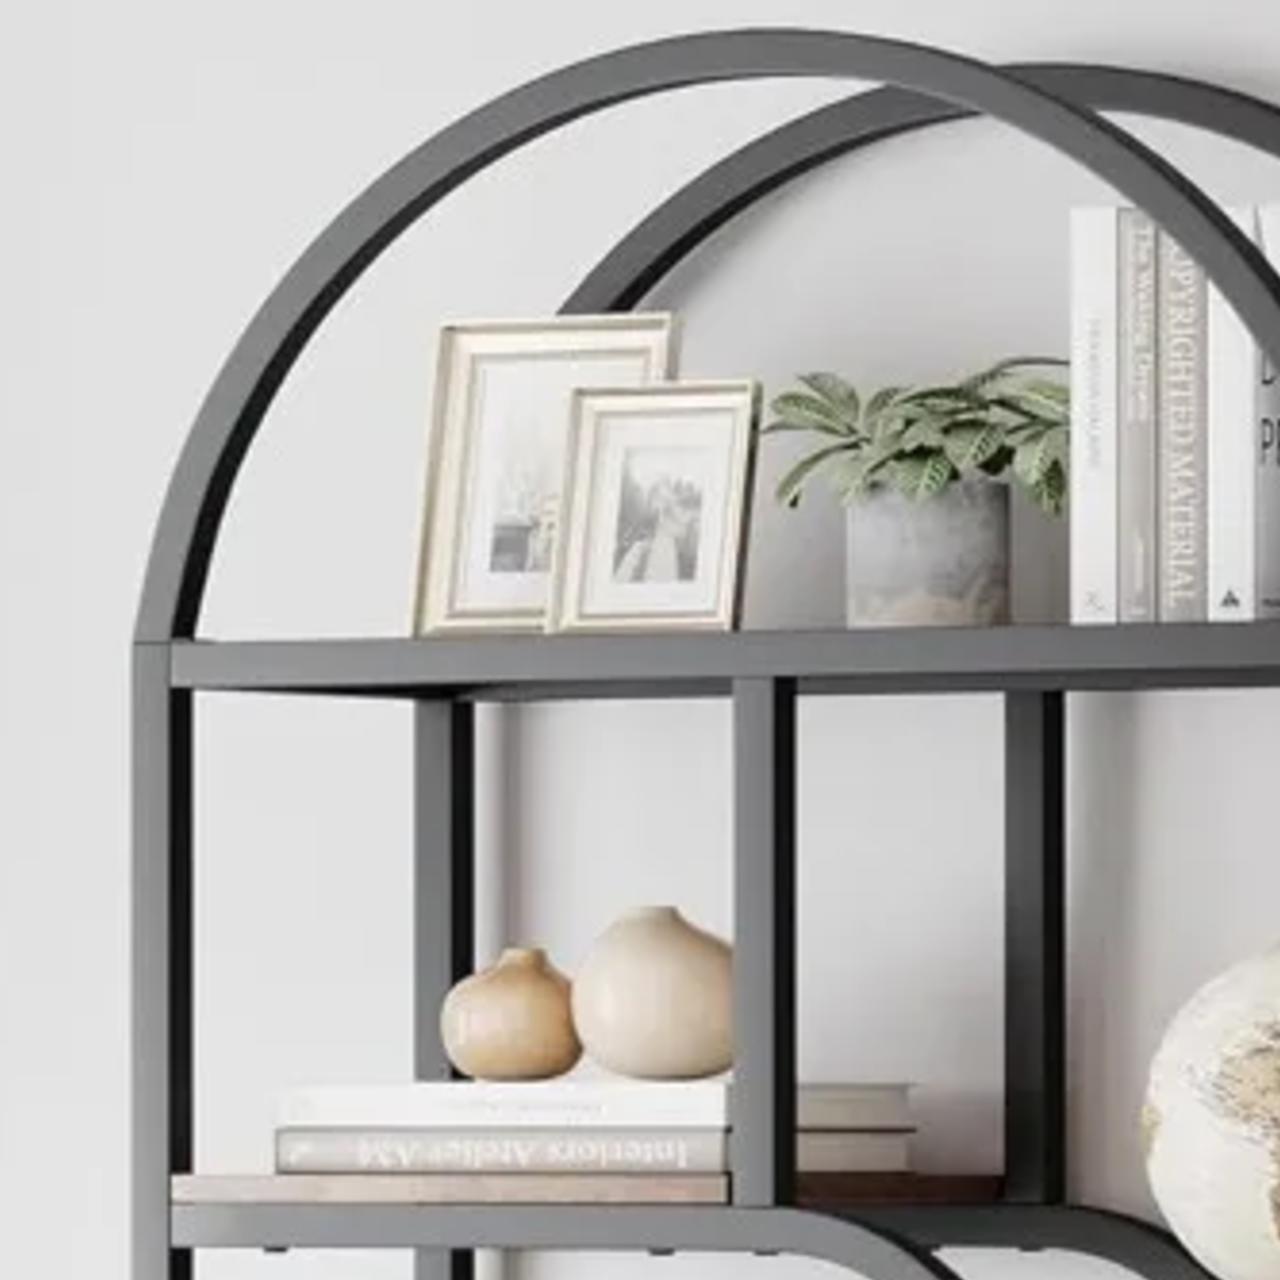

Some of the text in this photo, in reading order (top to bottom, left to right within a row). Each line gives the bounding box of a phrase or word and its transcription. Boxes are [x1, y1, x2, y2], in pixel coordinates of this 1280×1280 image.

[1169, 241, 1196, 608] OPYRIGHTED MATERIAL
[433, 1137, 531, 1168] Atelier
[549, 1137, 688, 1168] Interiors
